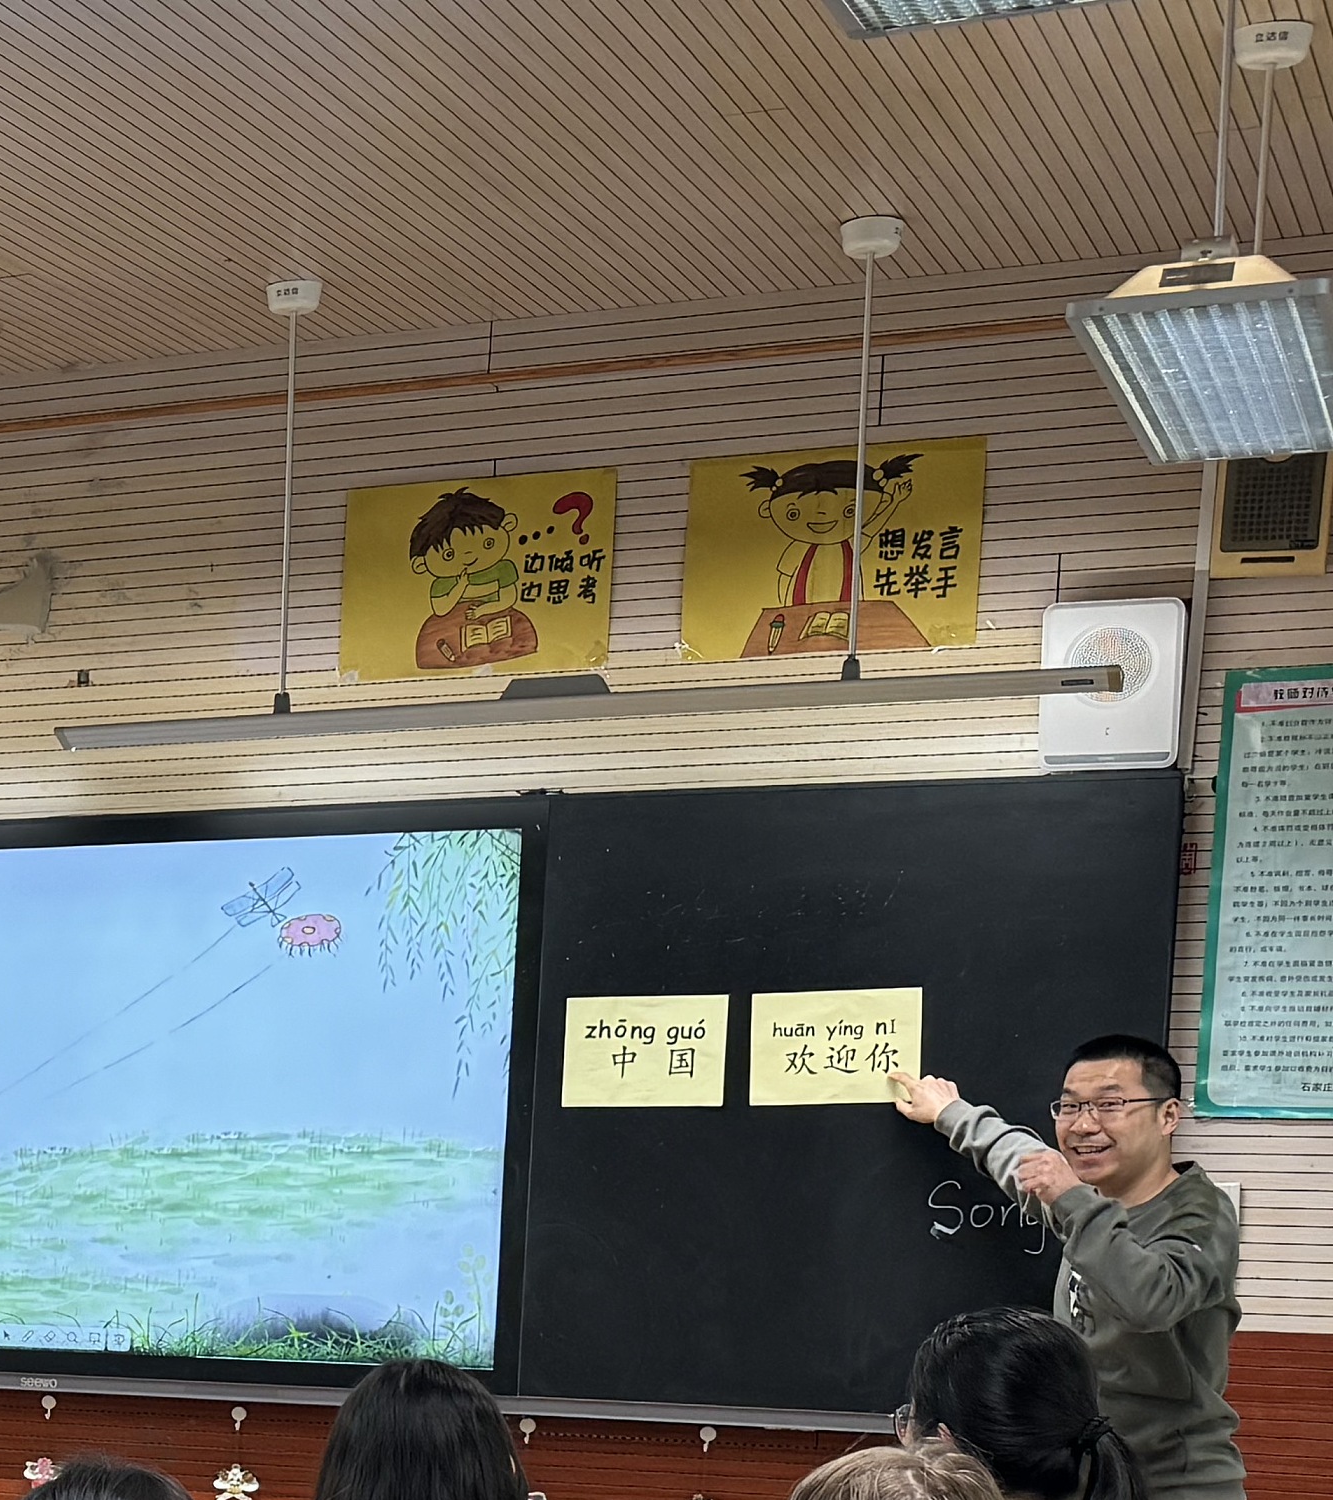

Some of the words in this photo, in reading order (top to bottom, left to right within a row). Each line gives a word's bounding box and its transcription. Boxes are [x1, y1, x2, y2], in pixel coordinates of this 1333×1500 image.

[878, 525, 964, 561] 想发言
[520, 575, 598, 605] 边思考
[873, 563, 958, 599] 先举手
[585, 1019, 655, 1046] zhōng
[666, 1019, 706, 1046] guó
[773, 1022, 815, 1037] huān
[826, 1019, 864, 1041] yíng
[611, 1046, 696, 1079] 中国
[784, 1042, 899, 1075] 欢迎你
